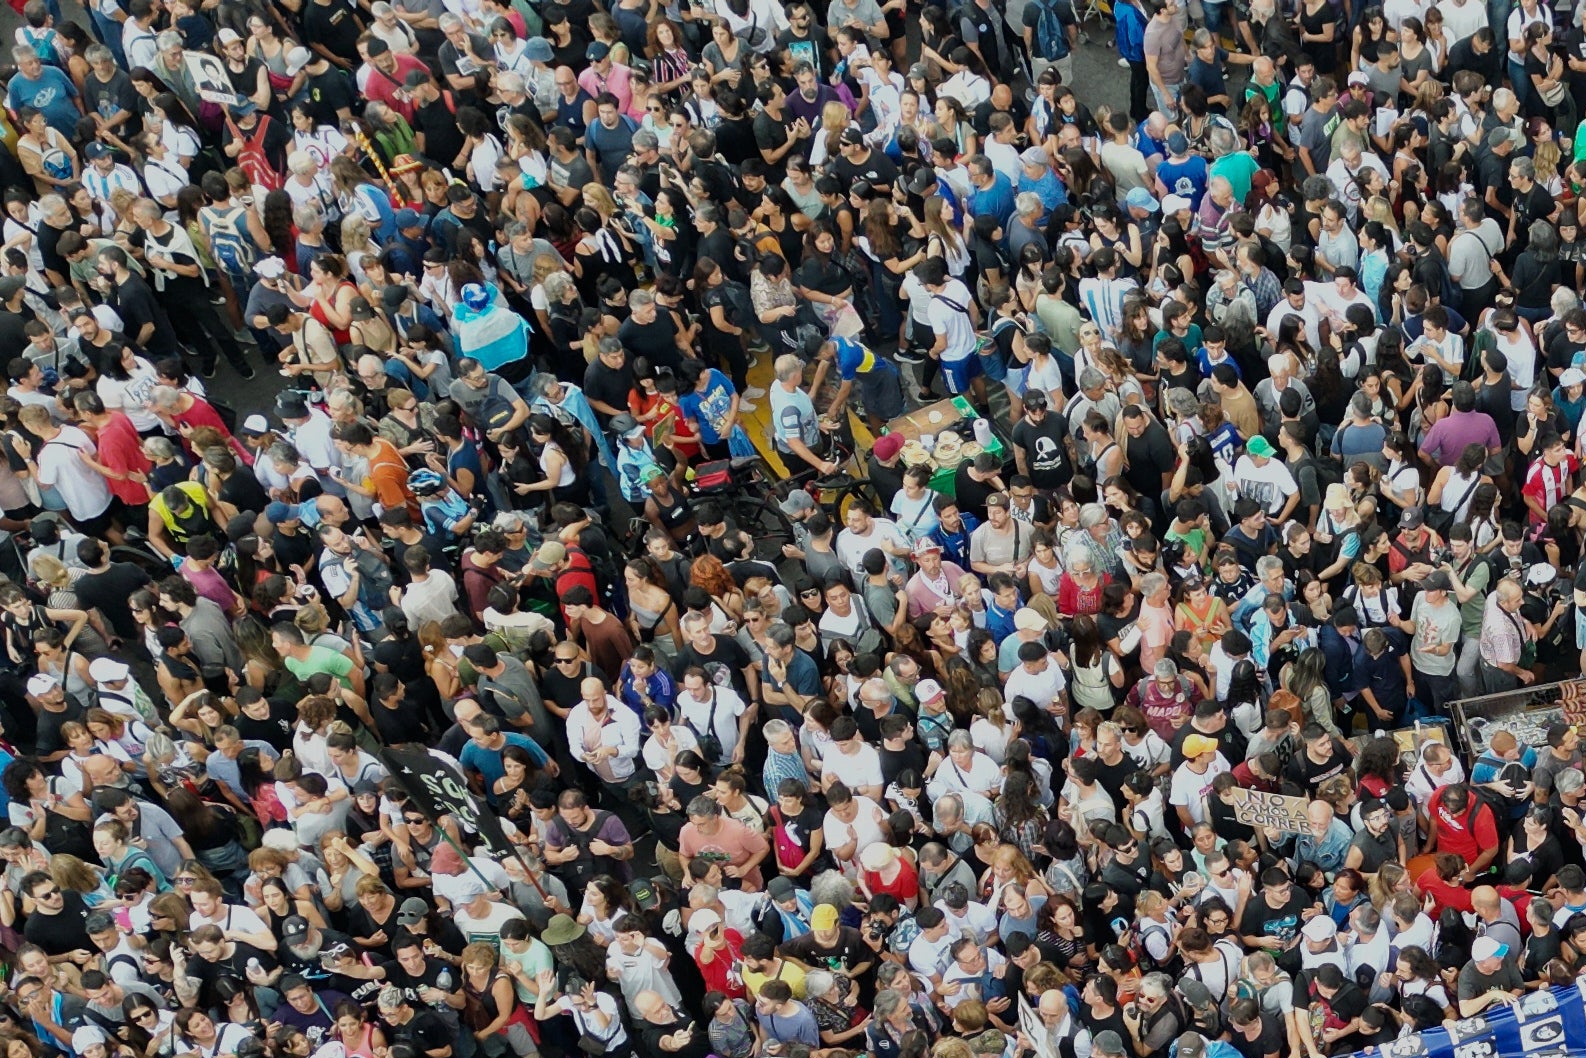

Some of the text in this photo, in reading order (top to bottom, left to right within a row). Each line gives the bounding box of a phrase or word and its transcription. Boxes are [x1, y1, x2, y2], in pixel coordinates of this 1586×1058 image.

[1247, 788, 1284, 807] NO
[1237, 800, 1306, 820] VAMOS A
[1240, 811, 1312, 833] CORRER
